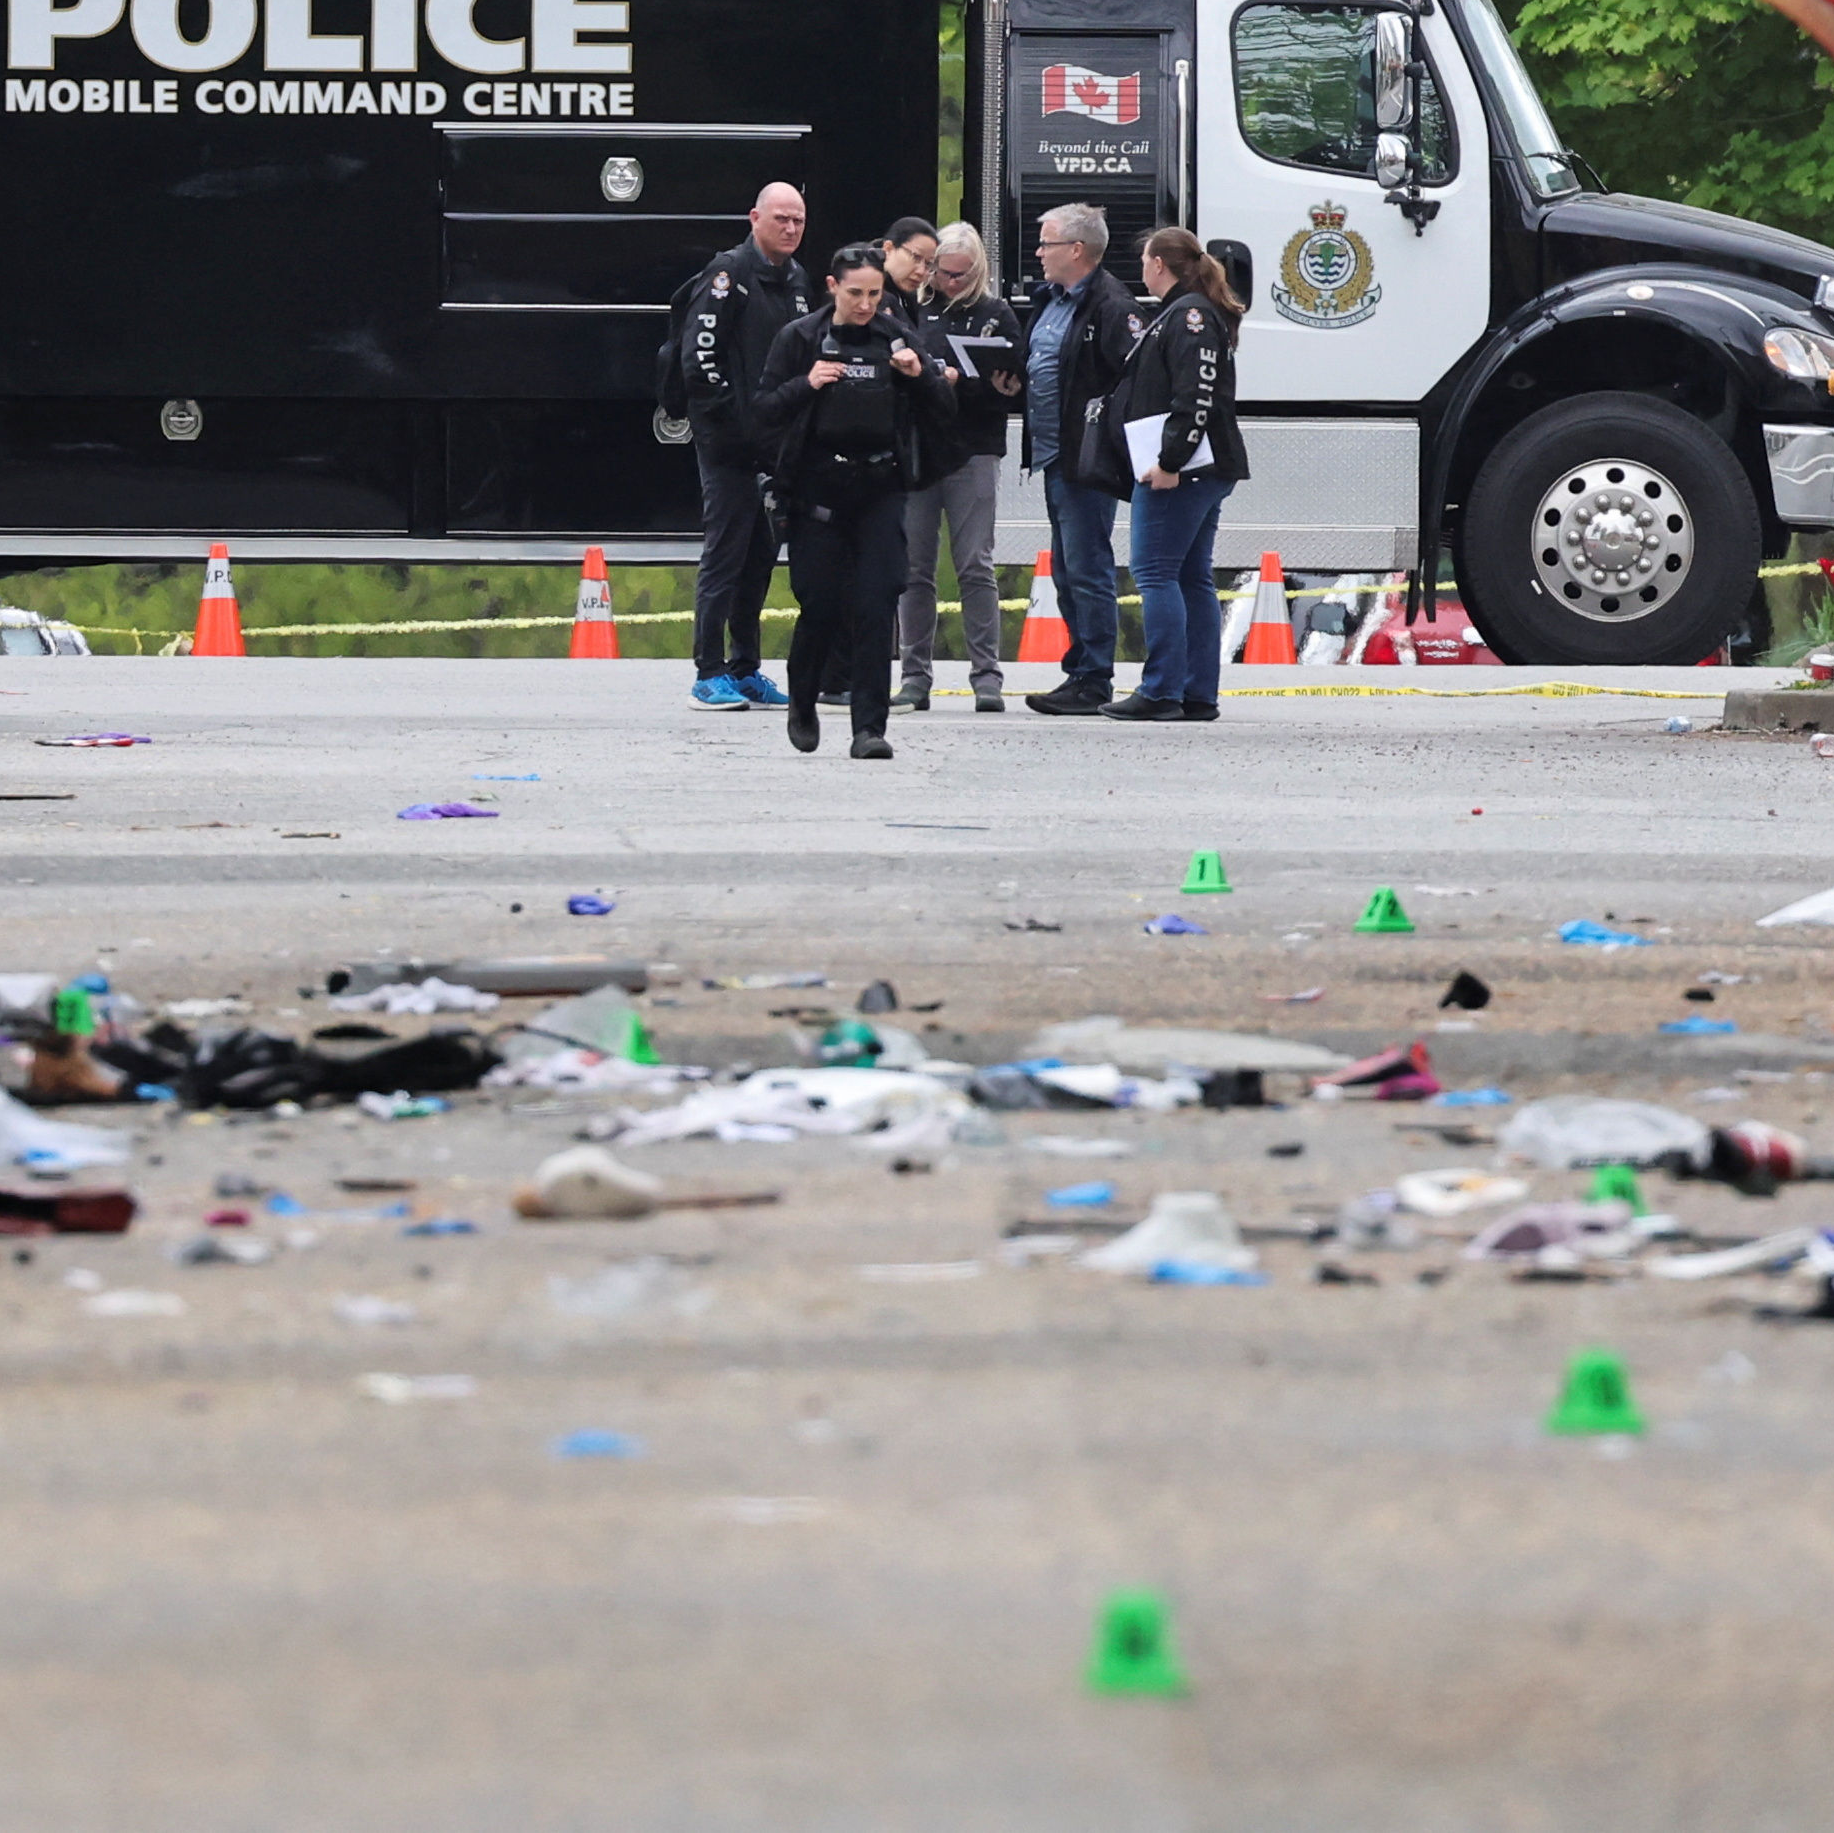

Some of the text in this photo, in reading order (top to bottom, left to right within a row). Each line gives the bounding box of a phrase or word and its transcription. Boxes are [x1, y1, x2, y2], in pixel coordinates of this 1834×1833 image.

[4, 79, 635, 116] MOBILE COMMAND CENTRE
[1038, 140, 1149, 156] Beyond the Call
[1053, 157, 1133, 173] VPD.CA
[696, 313, 729, 387] POLIC
[844, 369, 876, 379] OLICE
[1186, 347, 1217, 444] POLICE
